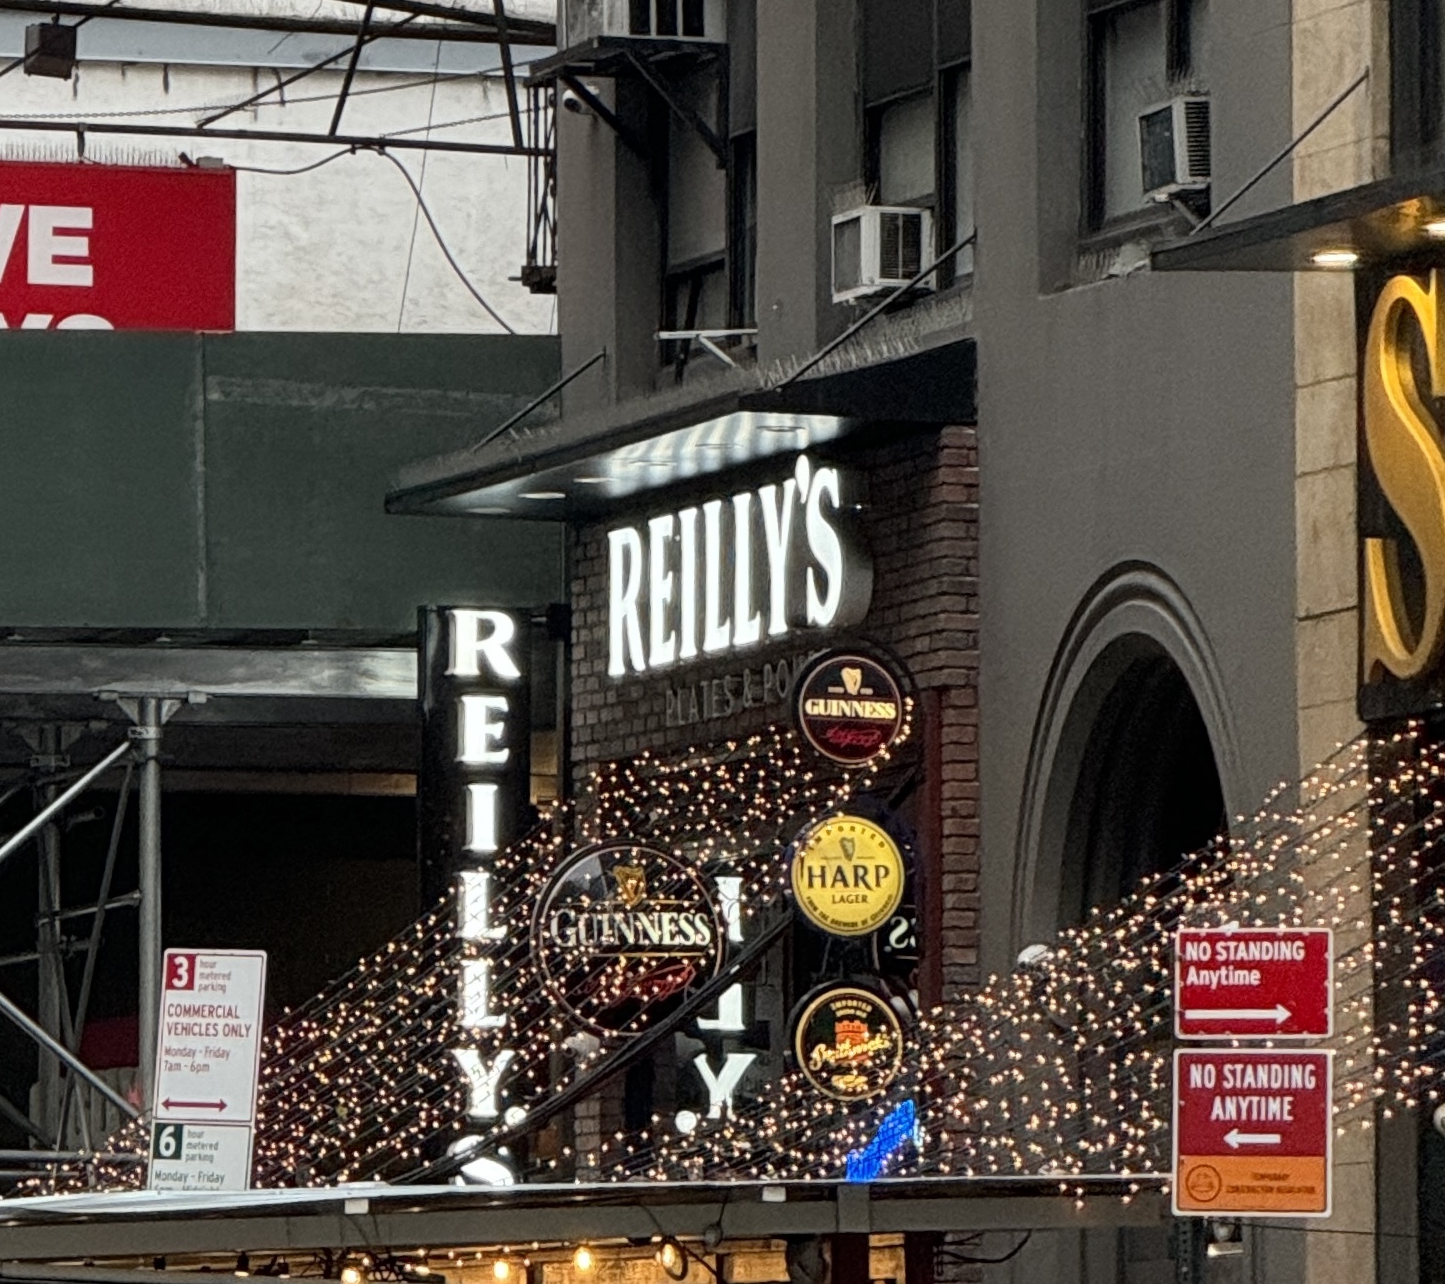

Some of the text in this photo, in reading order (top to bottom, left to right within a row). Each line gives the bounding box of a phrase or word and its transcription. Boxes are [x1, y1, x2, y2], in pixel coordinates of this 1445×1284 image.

[607, 454, 844, 678] REILLY'S
[804, 698, 897, 720] GUINNESS
[807, 864, 891, 892] HARP
[831, 893, 870, 905] LAGER
[549, 907, 712, 948] GUINNESS
[1185, 941, 1305, 962] NO STANDING
[172, 955, 189, 988] 3
[1185, 965, 1262, 991] Anytime
[198, 982, 227, 993] parking
[167, 1003, 240, 1019] COMMERCIAL
[166, 1022, 252, 1038] VEHICLES ONLY
[164, 1045, 196, 1059] Monday
[203, 1045, 231, 1060] Friday
[164, 1060, 182, 1072] 7am
[189, 1060, 210, 1074] 6pm
[1189, 1063, 1317, 1090] NO STANDING
[1210, 1095, 1295, 1122] ANYTIME
[159, 1125, 176, 1157] 6
[155, 1170, 188, 1183] Monday
[198, 1171, 225, 1185] Friday
